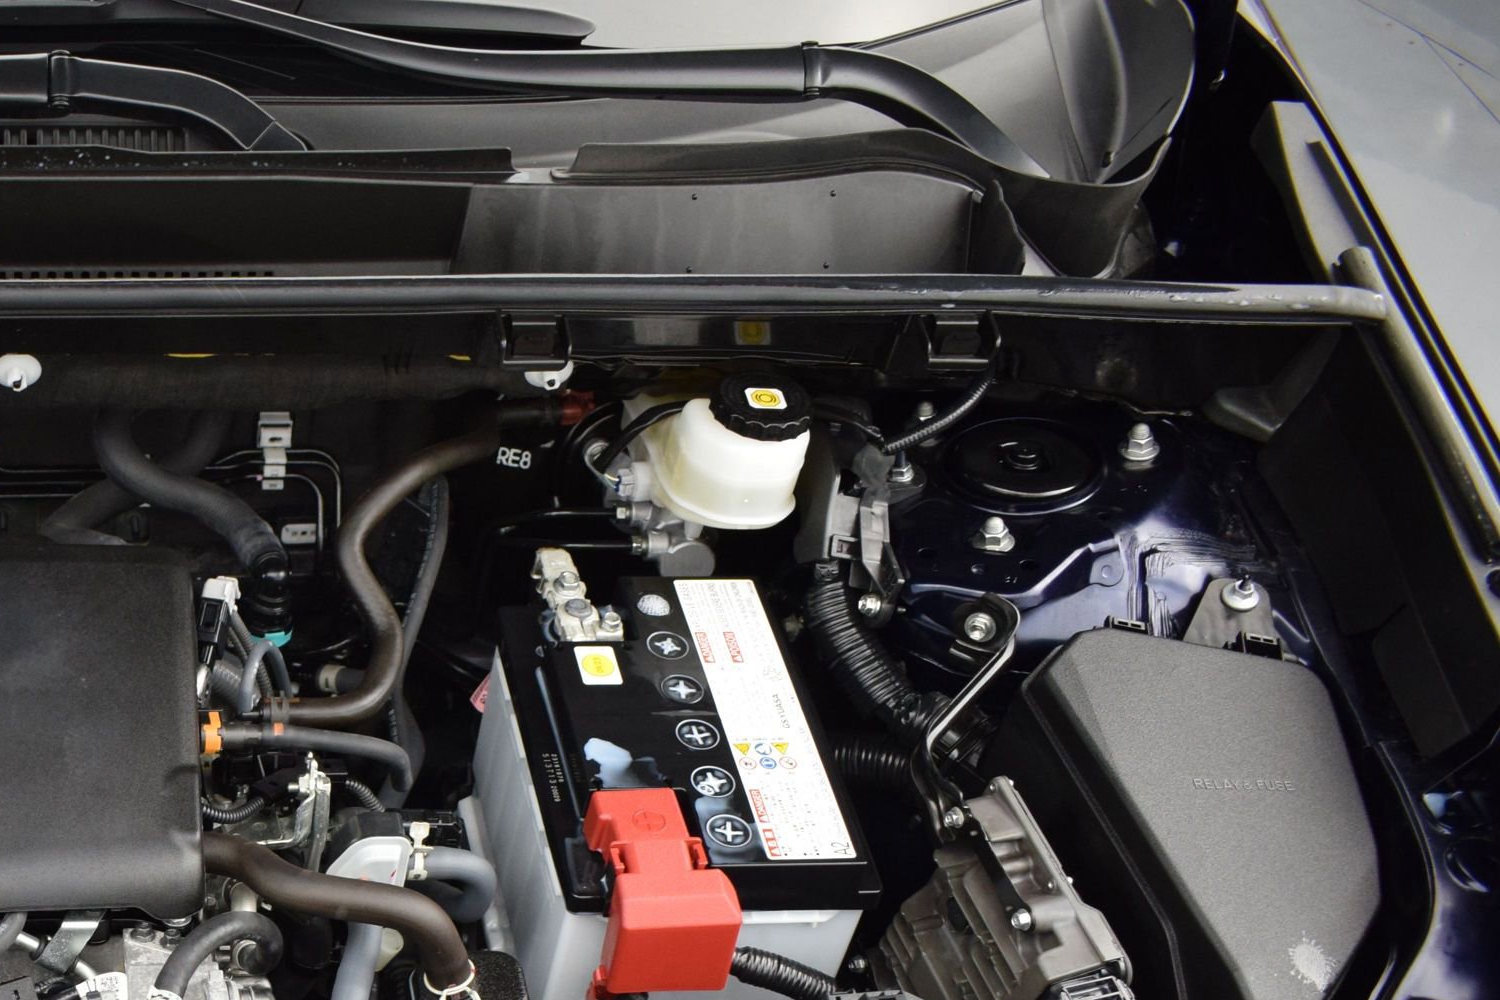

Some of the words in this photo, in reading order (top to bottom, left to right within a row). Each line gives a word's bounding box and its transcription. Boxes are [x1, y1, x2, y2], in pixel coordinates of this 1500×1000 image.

[496, 446, 532, 469] RE8
[723, 632, 741, 655] POISON
[1192, 778, 1239, 790] RELAY
[1243, 780, 1253, 790] &
[1255, 779, 1296, 792] FUSE
[829, 841, 853, 855] A2
